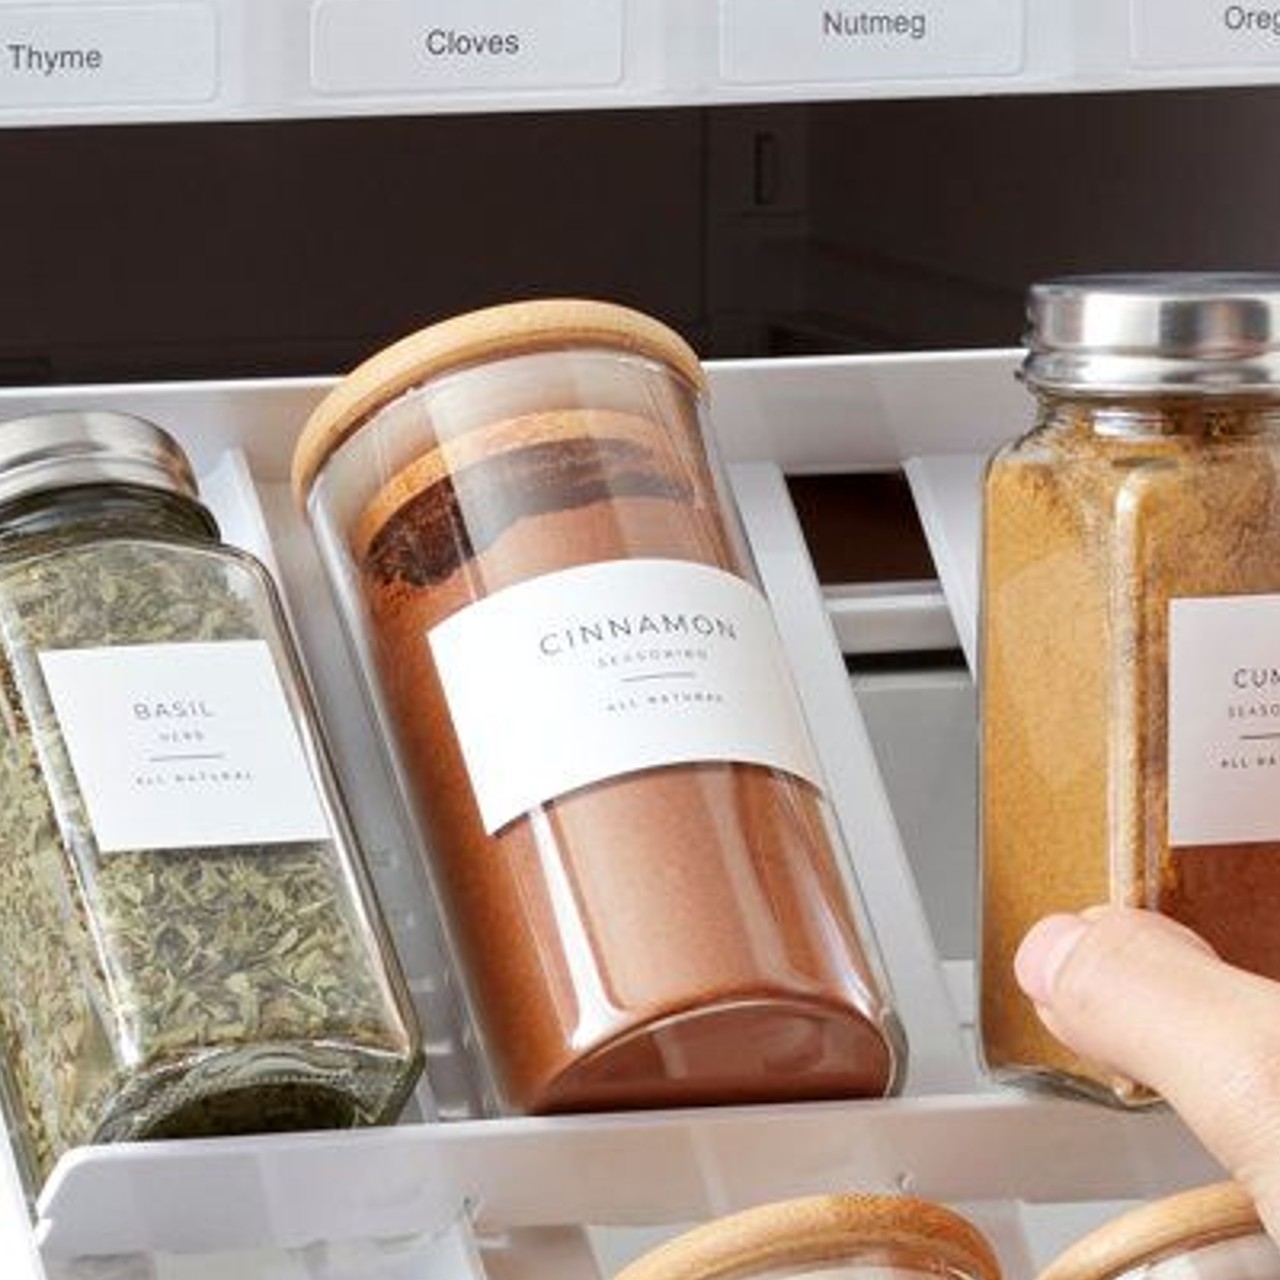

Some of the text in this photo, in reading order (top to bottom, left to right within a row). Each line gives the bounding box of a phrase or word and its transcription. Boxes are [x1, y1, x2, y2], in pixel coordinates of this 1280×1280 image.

[822, 10, 927, 41] Nutmeg
[425, 28, 521, 57] Cloves
[6, 43, 103, 78] Thyme
[538, 613, 738, 657] CINNAMON
[132, 700, 216, 721] BASIL
[1221, 757, 1250, 769] ALL
